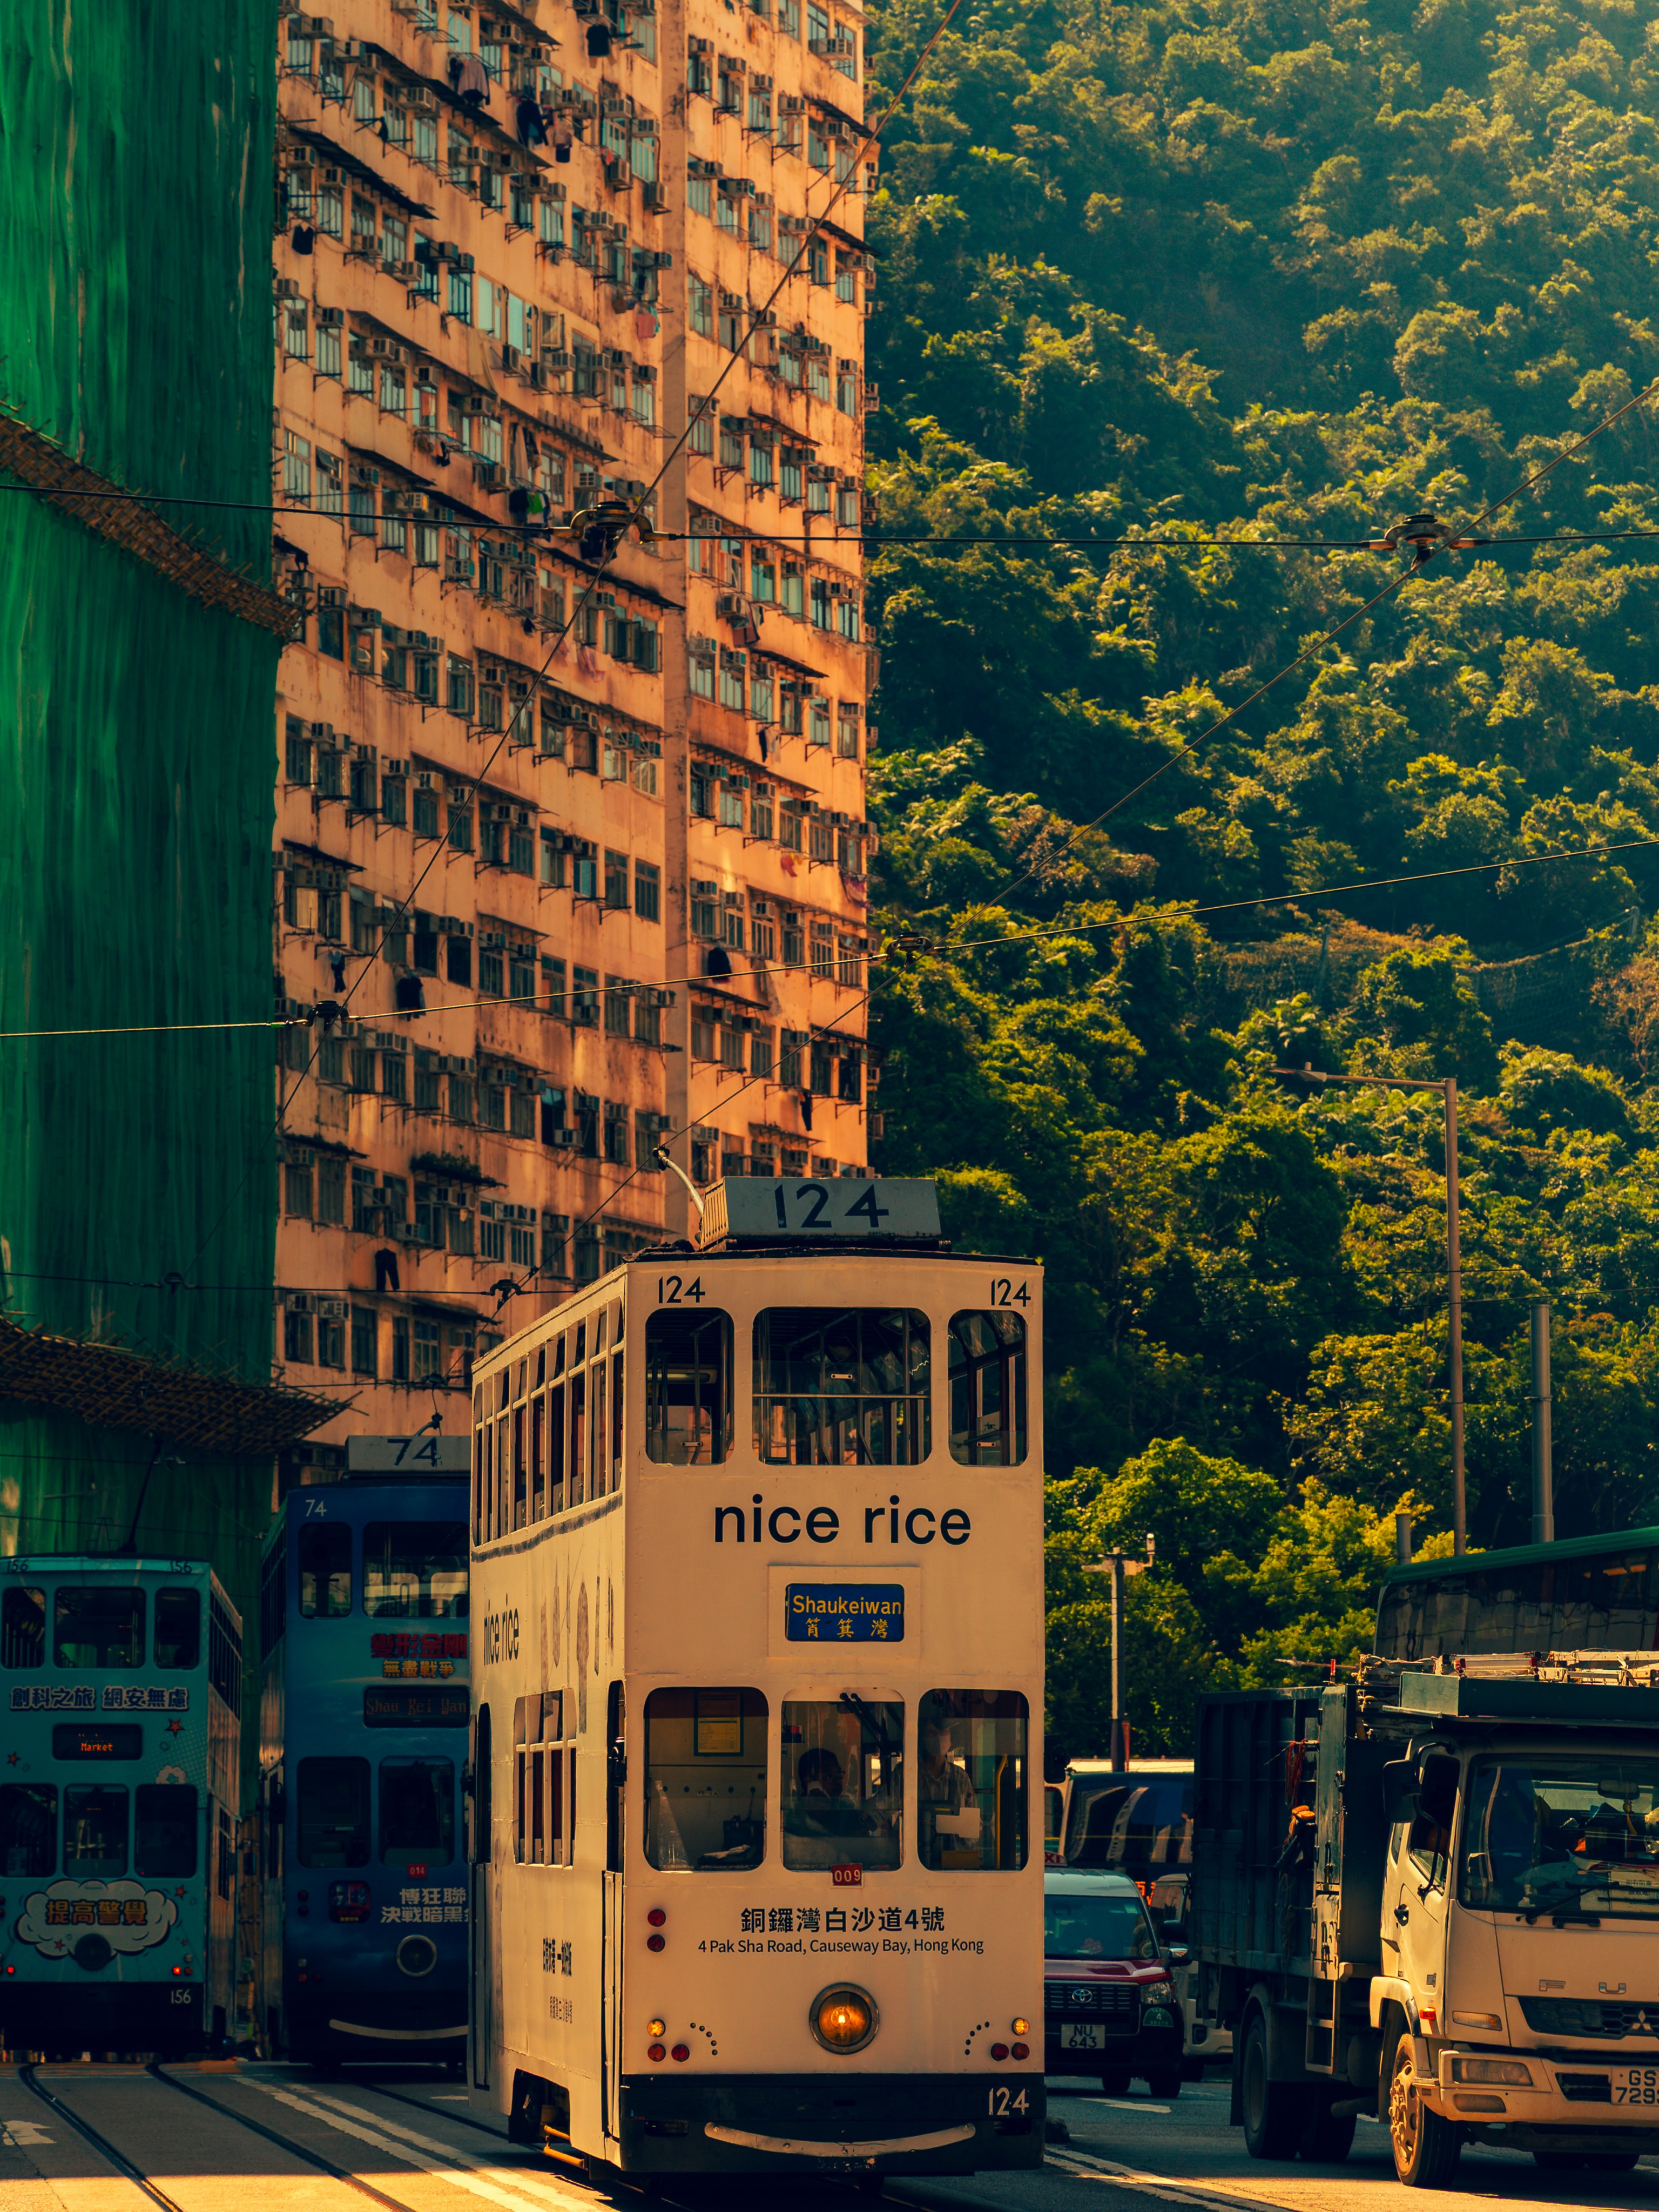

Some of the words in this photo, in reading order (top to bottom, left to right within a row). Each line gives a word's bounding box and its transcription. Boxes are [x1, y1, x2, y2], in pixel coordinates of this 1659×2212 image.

[774, 1183, 889, 1229] 124
[658, 1275, 706, 1304] 124
[991, 1278, 1031, 1307] 124
[387, 1437, 439, 1467] 74
[305, 1499, 327, 1517] 74
[714, 1493, 840, 1543] nice
[865, 1494, 972, 1545] rice
[7, 1559, 28, 1573] 156
[170, 1559, 192, 1574] 156
[792, 1595, 901, 1615] Shaukeiwan
[484, 1599, 500, 1666] nice
[502, 1593, 519, 1661] rice
[805, 1617, 889, 1639] 筲箕灣
[371, 1633, 467, 1658] 變形金剛
[383, 1660, 455, 1678] 無盡戰爭
[11, 1686, 96, 1710] 創科之旅
[102, 1686, 188, 1711] 網安無慮
[366, 1698, 399, 1715] Shau
[407, 1698, 431, 1715] Kei
[441, 1698, 467, 1716] Wan
[80, 1743, 113, 1752] Market
[410, 1866, 425, 1875] 014
[834, 1869, 861, 1883] 009
[399, 1887, 469, 1905] 博狂聯
[45, 1899, 148, 1925] 提高警覺
[740, 1906, 945, 1933] 銅鑼灣白沙道4號
[698, 1940, 707, 1952] 4
[710, 1939, 734, 1952] Pak
[738, 1939, 764, 1952] Sha
[767, 1939, 807, 1955] Road,
[810, 1940, 879, 1955] Causeway
[883, 1940, 911, 1954] Bay,
[914, 1939, 949, 1954] Hong
[952, 1938, 984, 1954] Kong
[171, 1989, 192, 2005] 156
[1539, 1979, 1659, 1997] FU
[1156, 2013, 1162, 2021] 4
[1074, 2025, 1092, 2036] NU
[1069, 2036, 1097, 2048] 643
[1629, 2069, 1657, 2086] GS
[989, 2087, 1029, 2116] 124
[1615, 2087, 1659, 2104] 729
